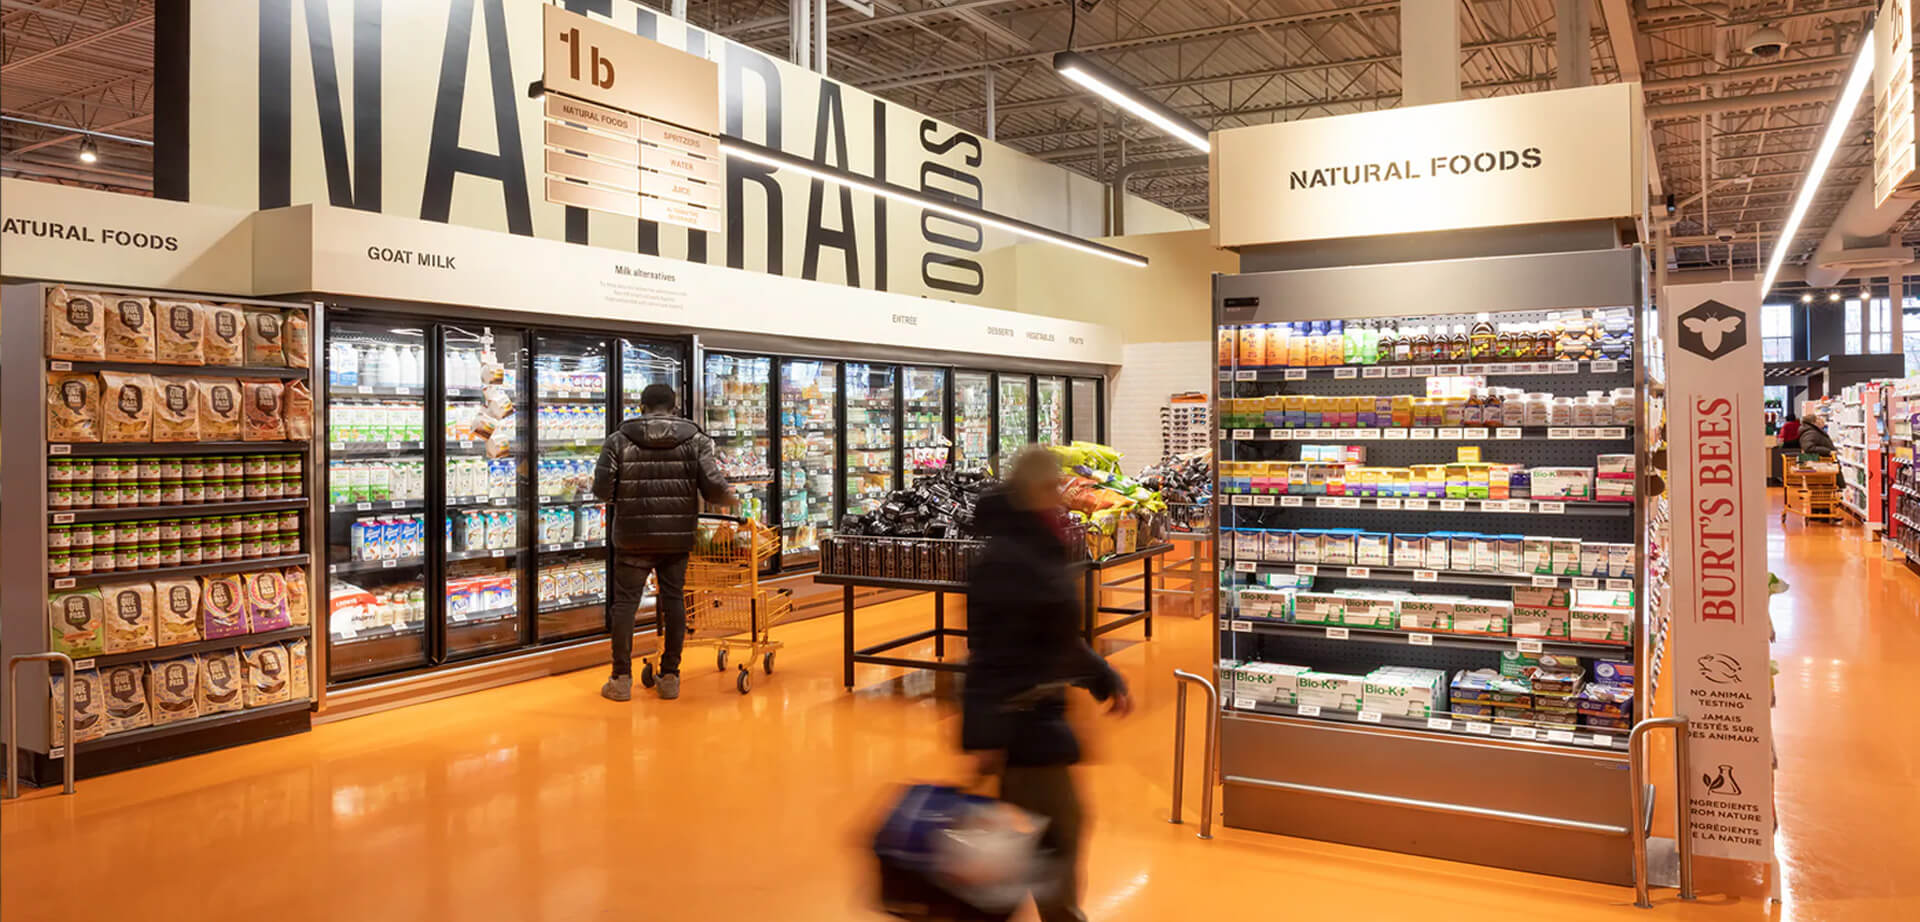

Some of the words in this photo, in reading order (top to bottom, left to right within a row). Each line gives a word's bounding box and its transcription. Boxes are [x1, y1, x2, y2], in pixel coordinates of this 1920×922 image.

[560, 27, 615, 90] 1b
[563, 105, 600, 121] NATURAL
[600, 115, 629, 129] FOODS
[670, 159, 694, 171] WATER
[1289, 160, 1420, 190] NATURAL
[1431, 147, 1542, 177] FOODS
[919, 118, 984, 303] OODS
[2, 217, 95, 243] ATURAL
[102, 229, 179, 252] FOODS
[367, 246, 413, 265] GOAT
[417, 251, 456, 270] MILK
[615, 264, 632, 276] Milk
[633, 268, 676, 282] alternatives
[1697, 397, 1734, 487] BEES
[1699, 497, 1736, 623] BURT'S
[1690, 689, 1707, 697] NO
[1710, 690, 1752, 700] ANIMAL
[1699, 699, 1744, 709] TESTING
[1702, 713, 1742, 723] JAMAIS
[1691, 721, 1729, 731] TESTÉS
[1733, 725, 1754, 733] SUR
[1709, 733, 1759, 743] ANIMAUX
[1689, 799, 1759, 812] NGREDIENTS
[1691, 808, 1715, 817] ROM
[1718, 811, 1762, 822] NATURE
[1689, 822, 1759, 836] NGRÉDIENTS
[1701, 832, 1715, 841] LA
[1718, 835, 1762, 846] NATURE
